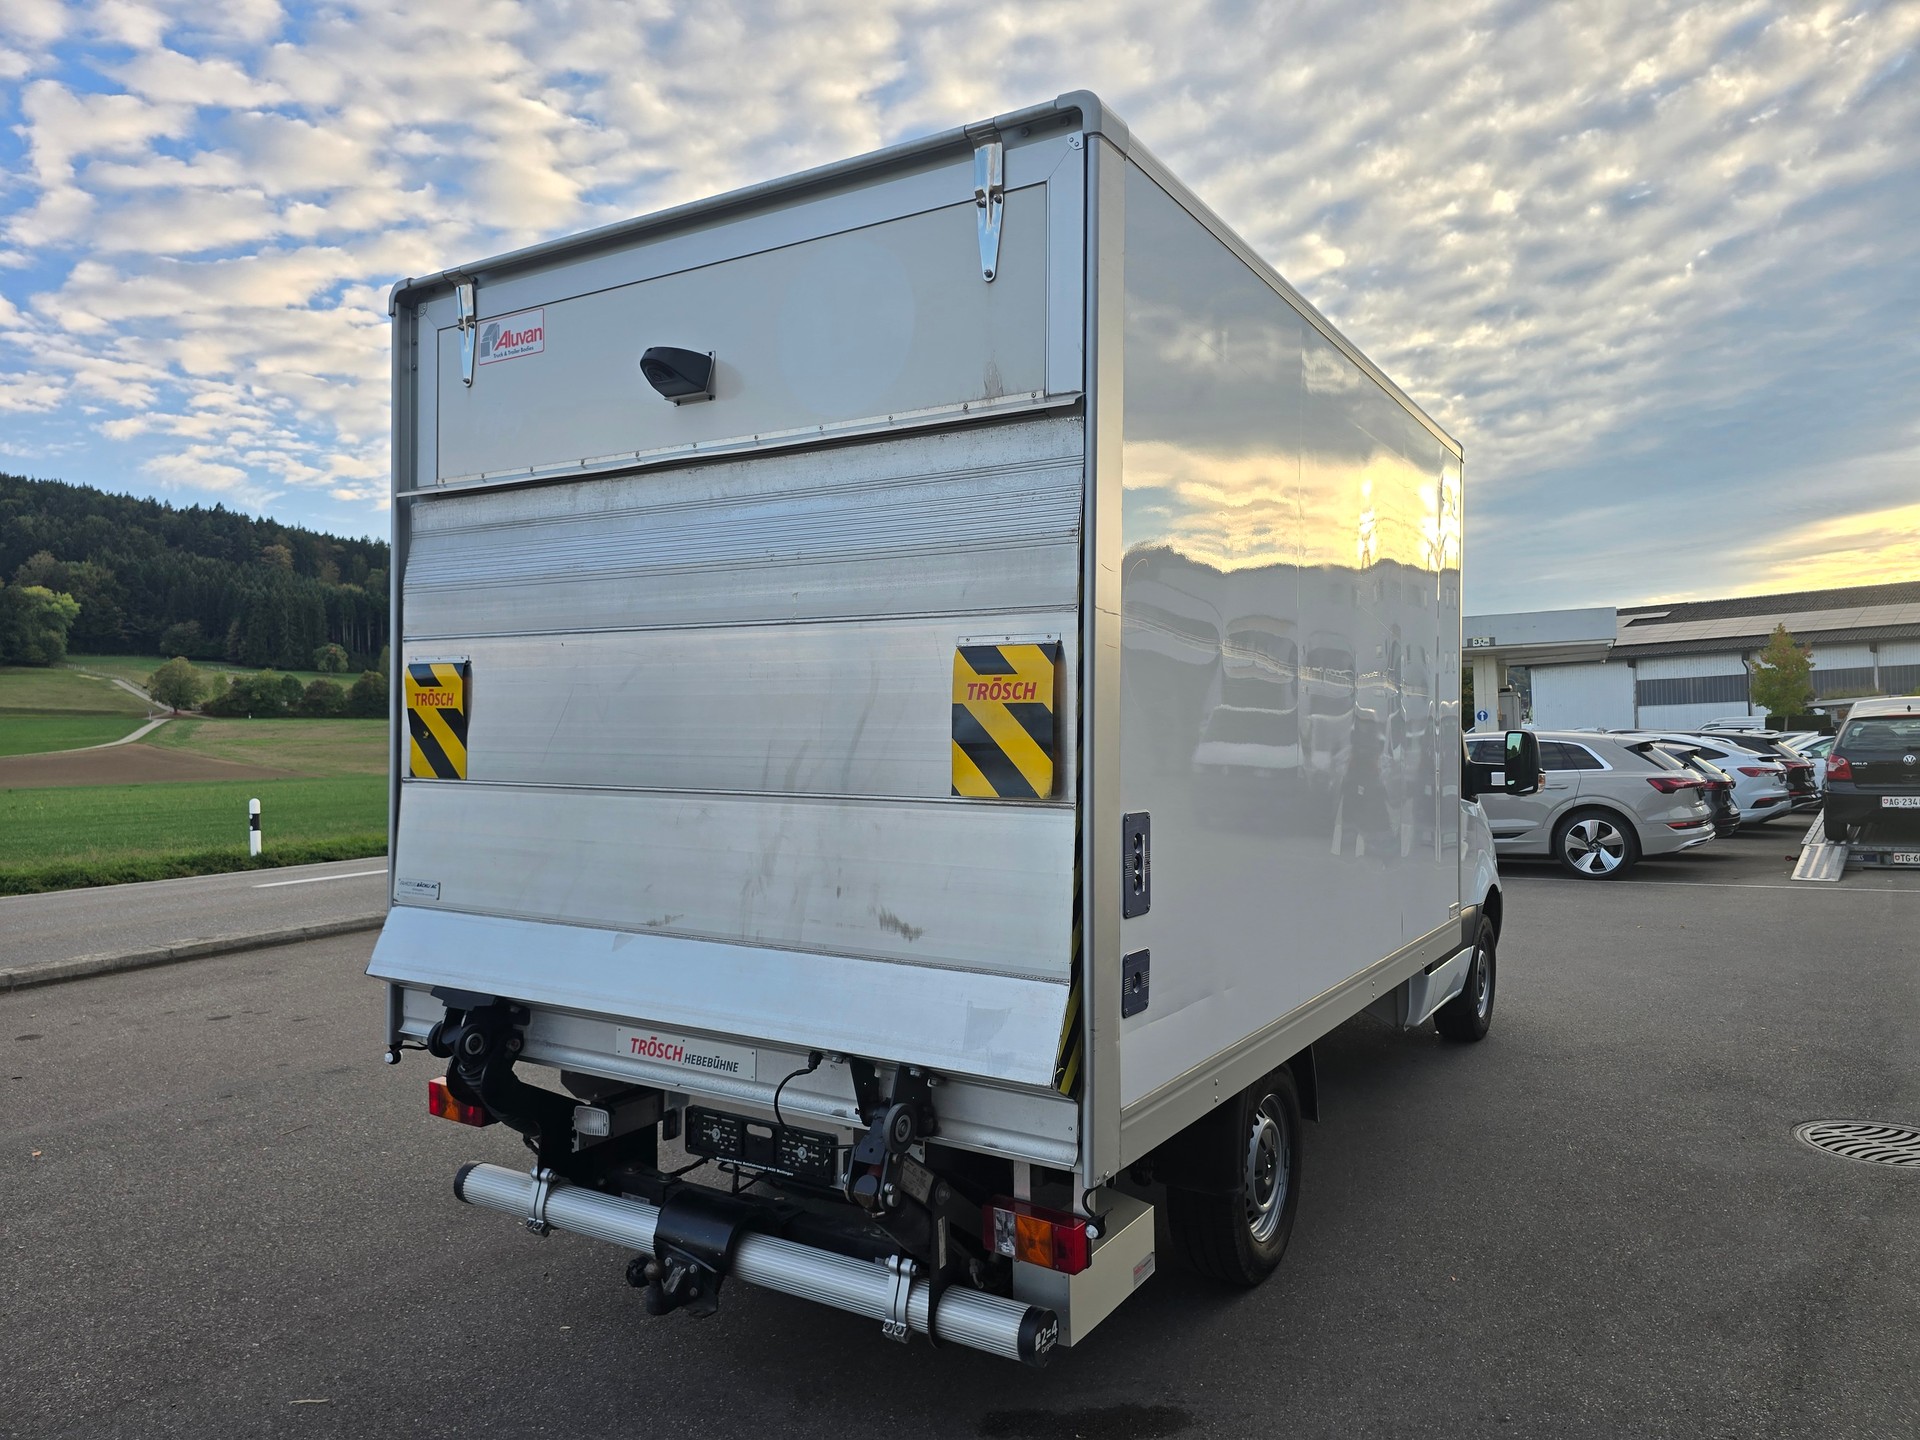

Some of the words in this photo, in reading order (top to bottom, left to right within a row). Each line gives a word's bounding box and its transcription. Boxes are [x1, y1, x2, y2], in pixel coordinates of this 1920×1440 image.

[494, 327, 542, 351] Aluvan
[415, 689, 454, 706] TRÖSCH
[967, 677, 1037, 701] TRÖSCH
[631, 1036, 684, 1062] TRÖSCH
[684, 1053, 739, 1073] HEBEBÜHNE
